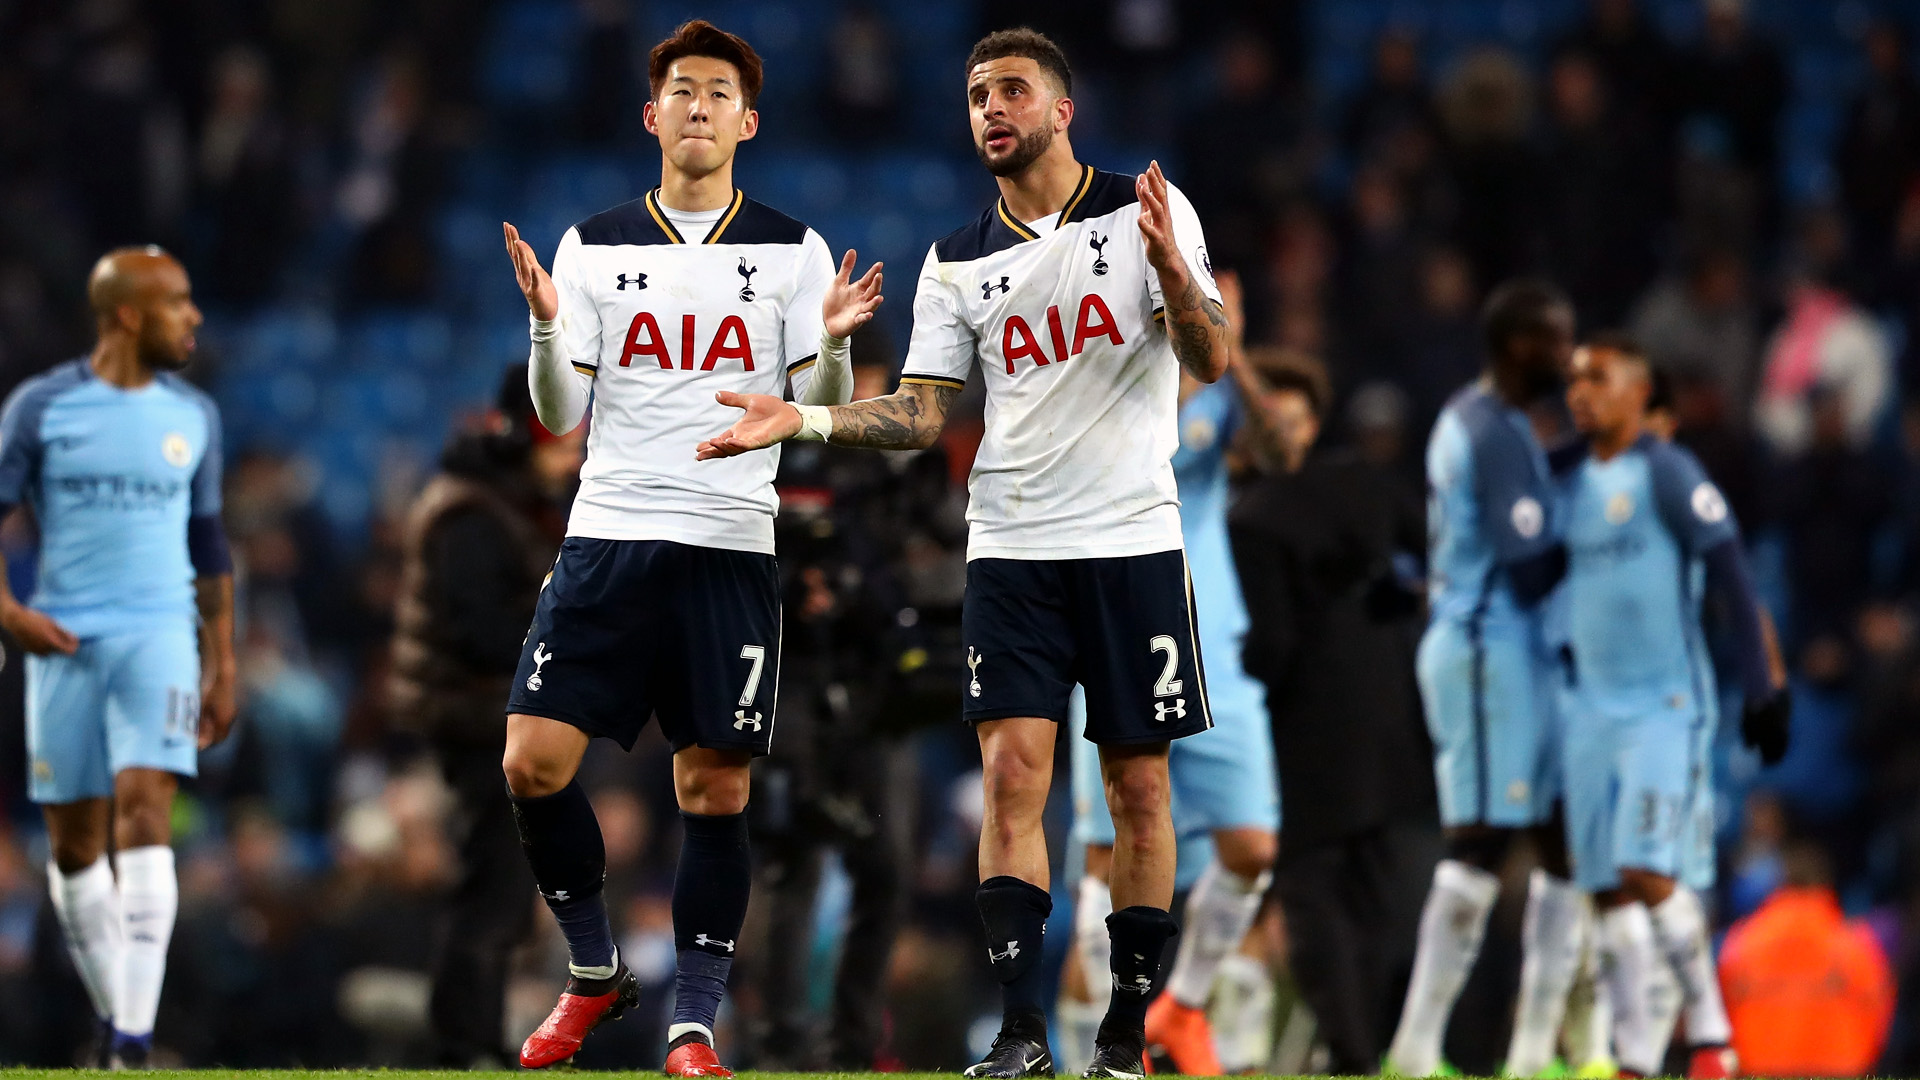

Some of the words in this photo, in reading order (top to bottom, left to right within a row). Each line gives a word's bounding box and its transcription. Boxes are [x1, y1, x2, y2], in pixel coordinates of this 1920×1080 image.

[619, 312, 755, 371] AIA
[1002, 293, 1125, 375] AIA
[739, 645, 765, 706] 7
[1150, 635, 1182, 697] 2
